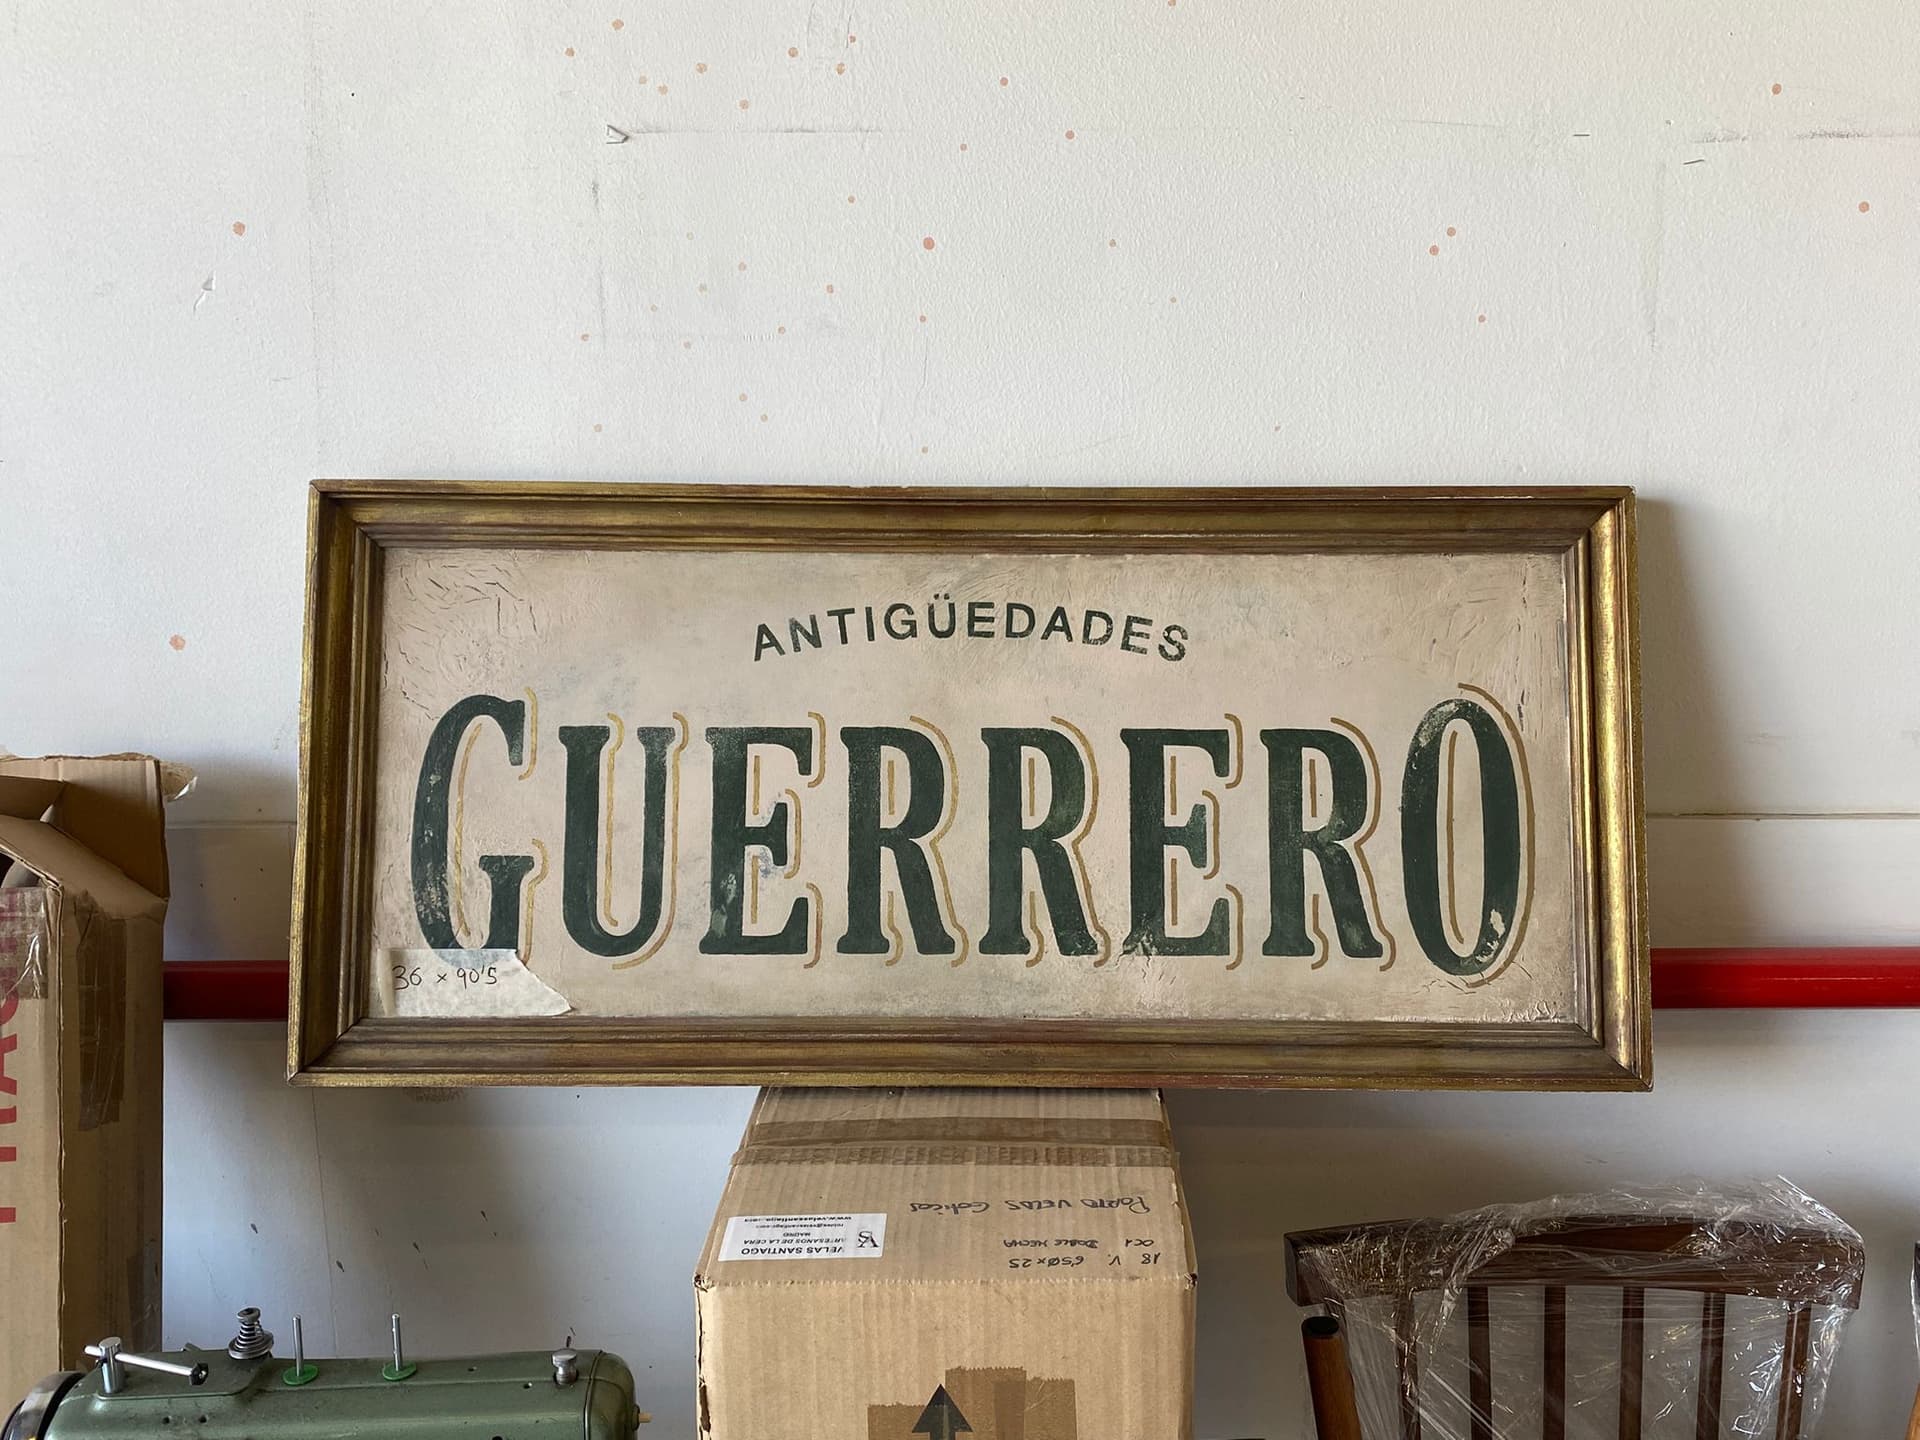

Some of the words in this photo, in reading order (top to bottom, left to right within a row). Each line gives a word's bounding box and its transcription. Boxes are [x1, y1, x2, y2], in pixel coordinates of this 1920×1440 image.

[753, 593, 1189, 662] ANTIGÜEDADES
[409, 684, 1534, 987] GUERRERO
[392, 965, 422, 990] 36
[741, 1247, 803, 1255] SANTIAGO
